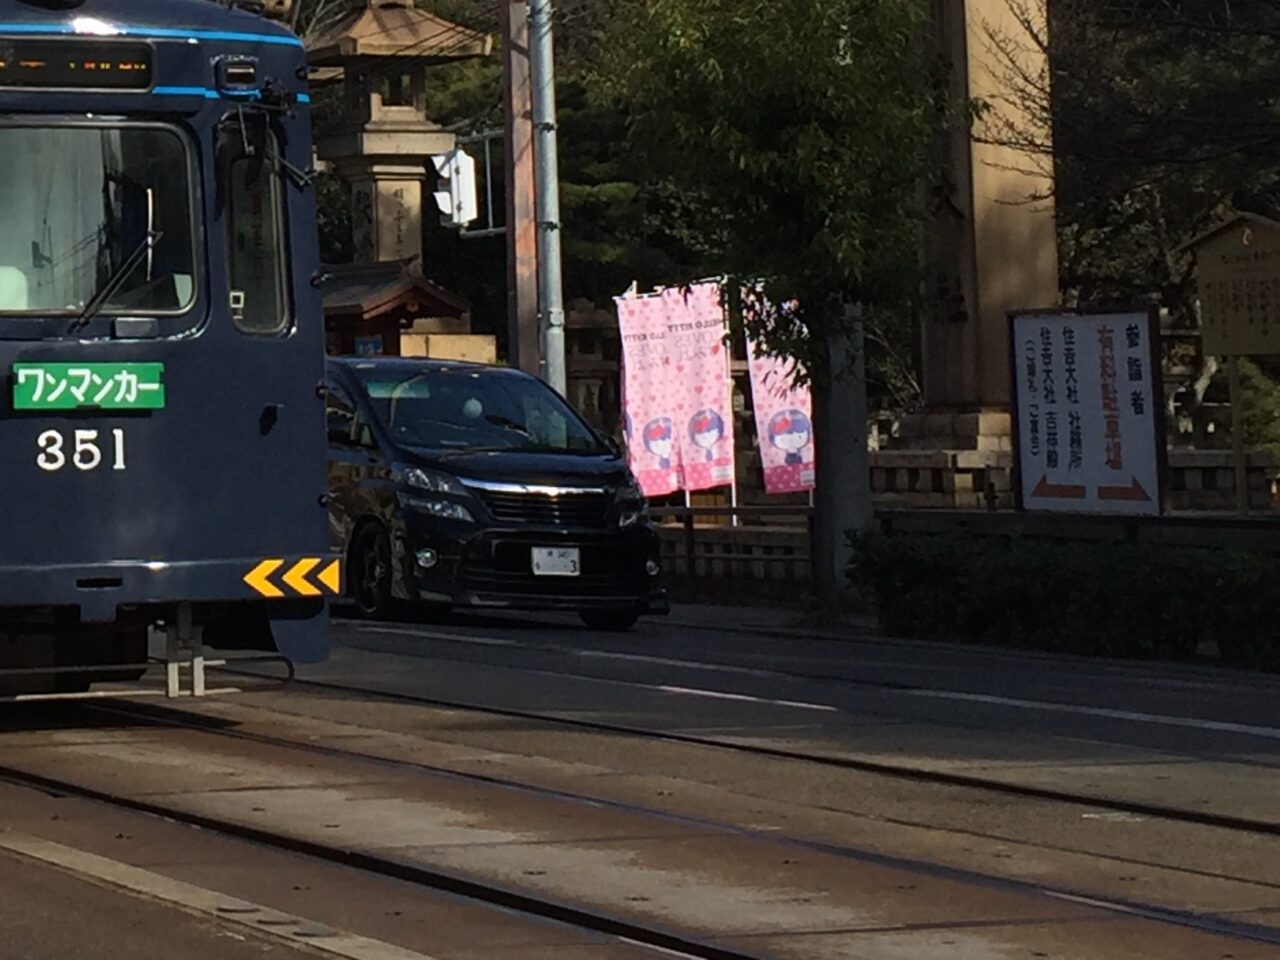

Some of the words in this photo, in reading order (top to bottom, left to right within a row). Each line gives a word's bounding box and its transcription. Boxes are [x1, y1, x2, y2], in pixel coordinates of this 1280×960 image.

[18, 368, 160, 403] ワンマンカー
[1039, 326, 1057, 405] 住吉大社
[1062, 326, 1080, 405] 住吉大社
[36, 428, 126, 471] 351
